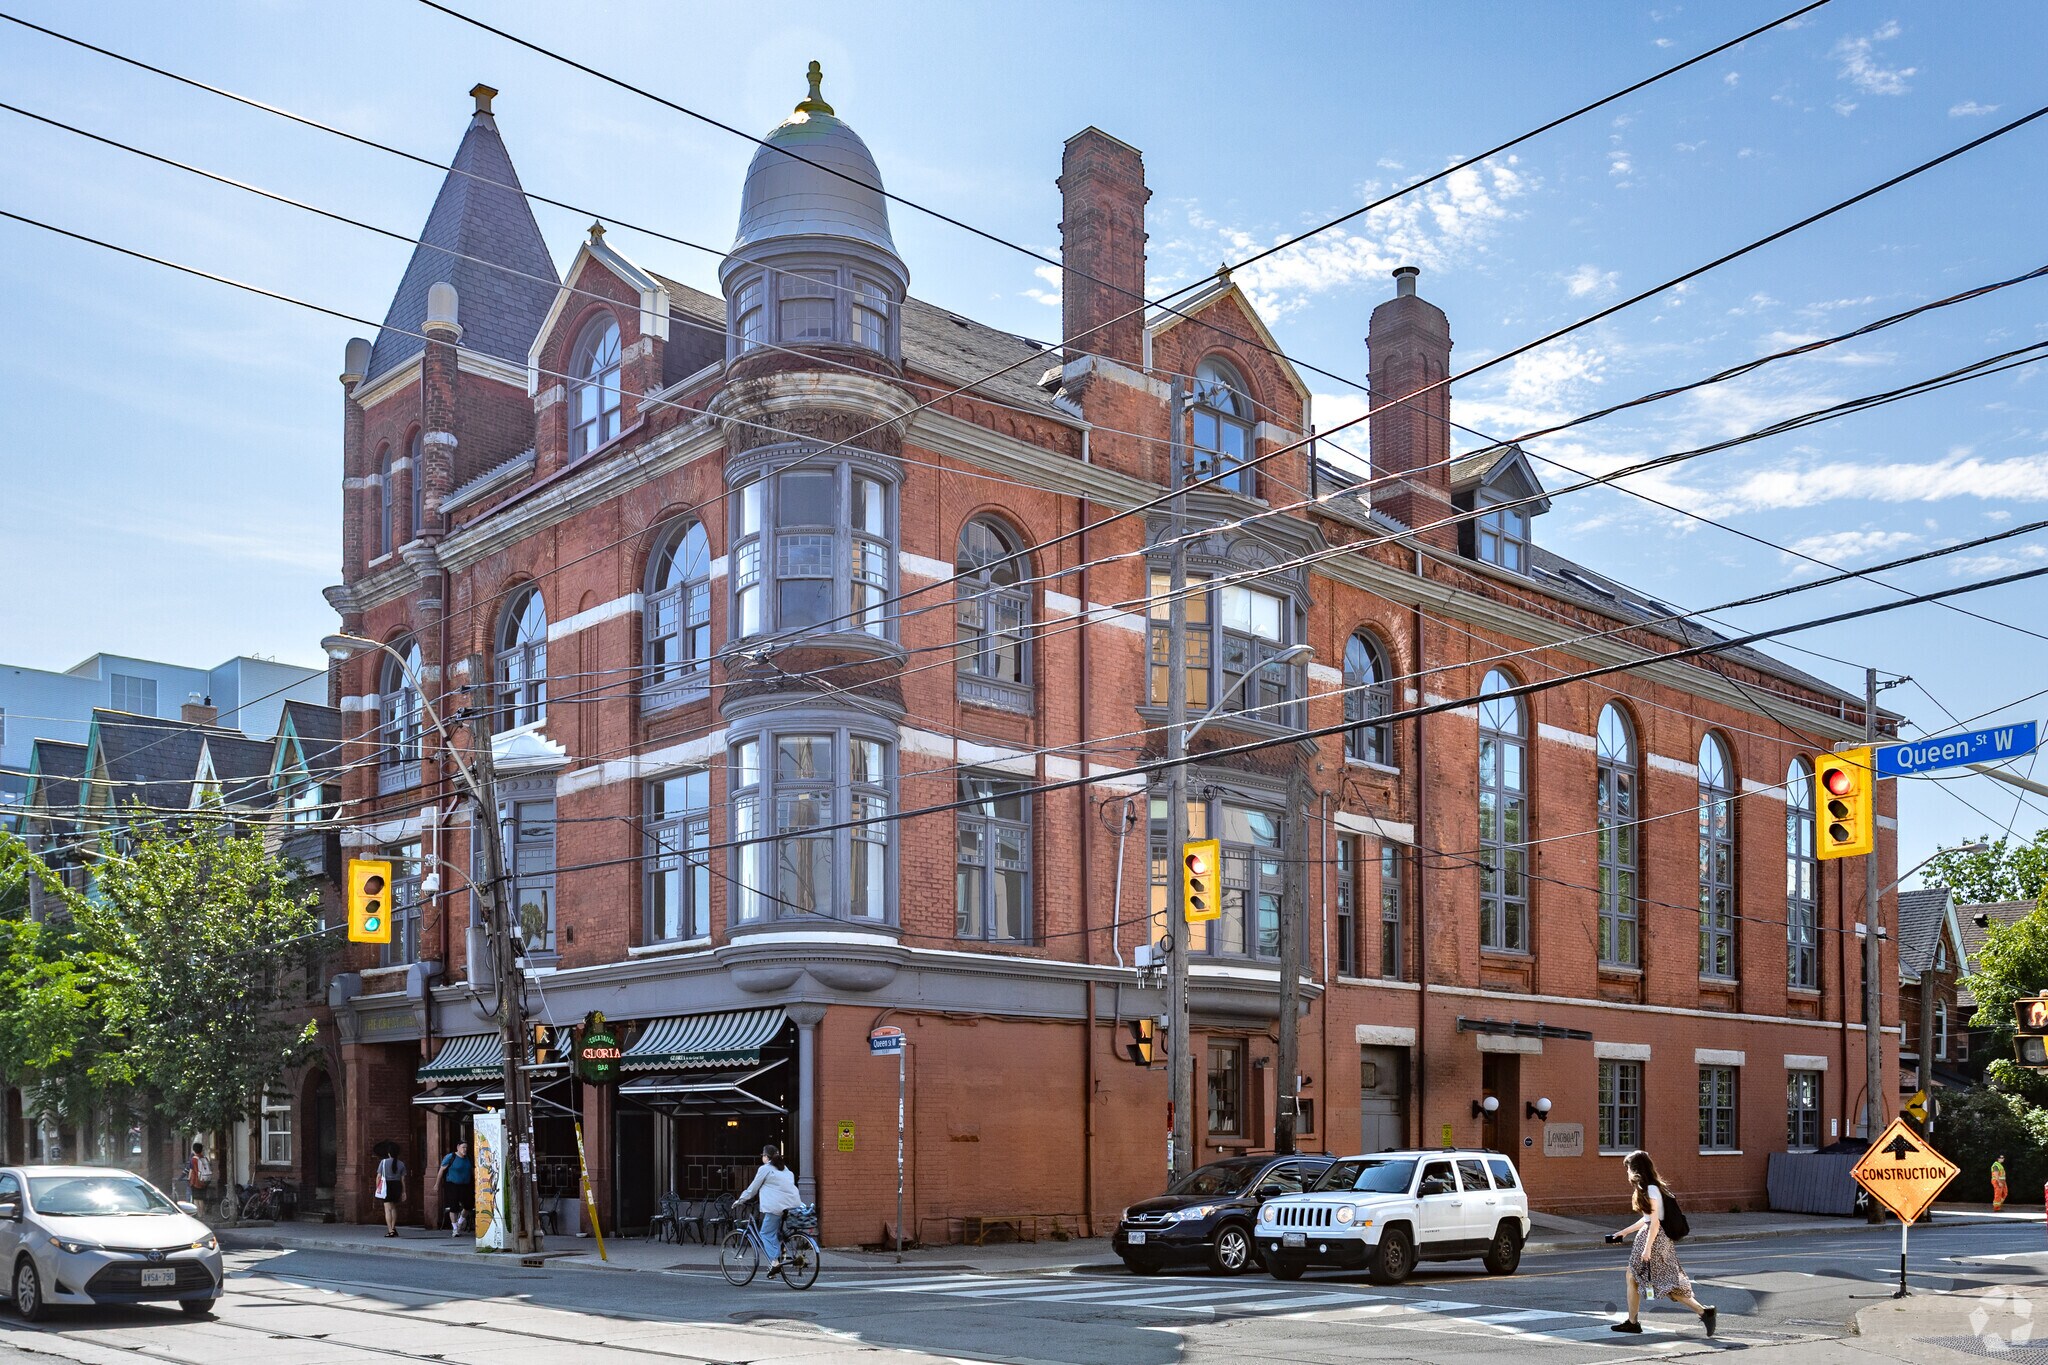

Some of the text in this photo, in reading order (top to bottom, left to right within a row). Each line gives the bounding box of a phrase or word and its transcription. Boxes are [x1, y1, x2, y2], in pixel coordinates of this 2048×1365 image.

[1897, 728, 2014, 769] Queen St W
[588, 1034, 614, 1045] COCKTAILS
[873, 1039, 888, 1048] Queen
[583, 1048, 622, 1059] GLORIA
[1547, 1131, 1580, 1146] LONGBOAT
[1862, 1167, 1947, 1180] CONSTRUCTION
